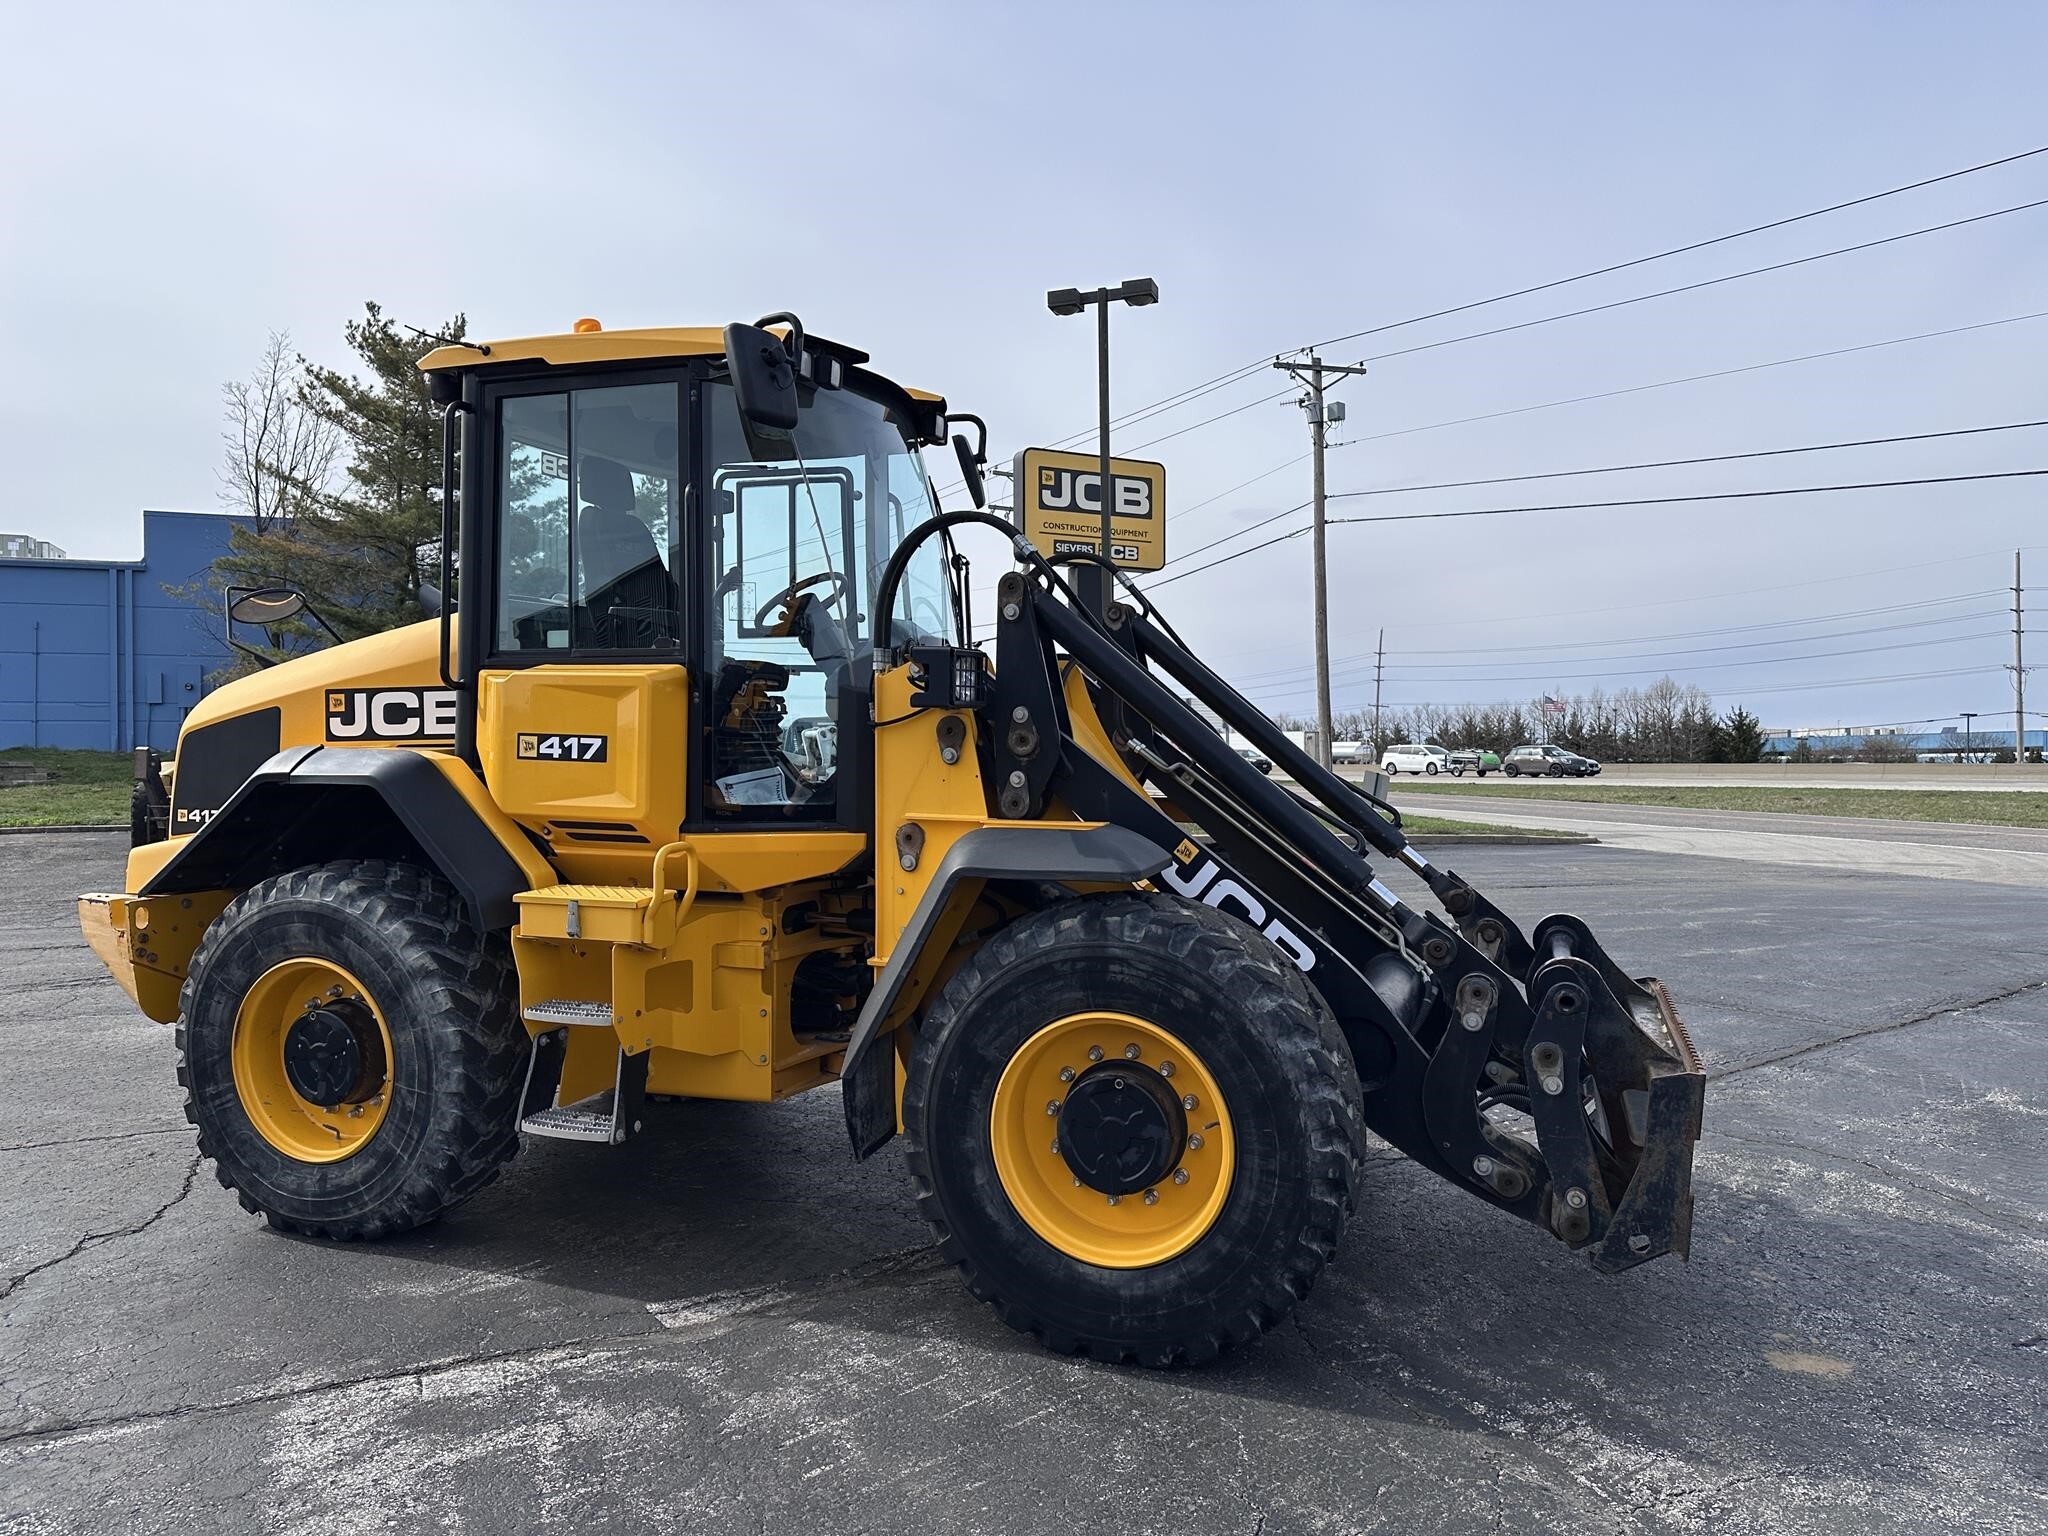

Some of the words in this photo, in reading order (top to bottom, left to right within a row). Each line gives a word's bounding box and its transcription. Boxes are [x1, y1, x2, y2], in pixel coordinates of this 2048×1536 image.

[1041, 472, 1150, 515] JCB
[1110, 527, 1148, 538] QUIPMENT
[1055, 542, 1094, 554] SIEVERS
[1101, 545, 1138, 560] CB
[539, 736, 602, 760] 417
